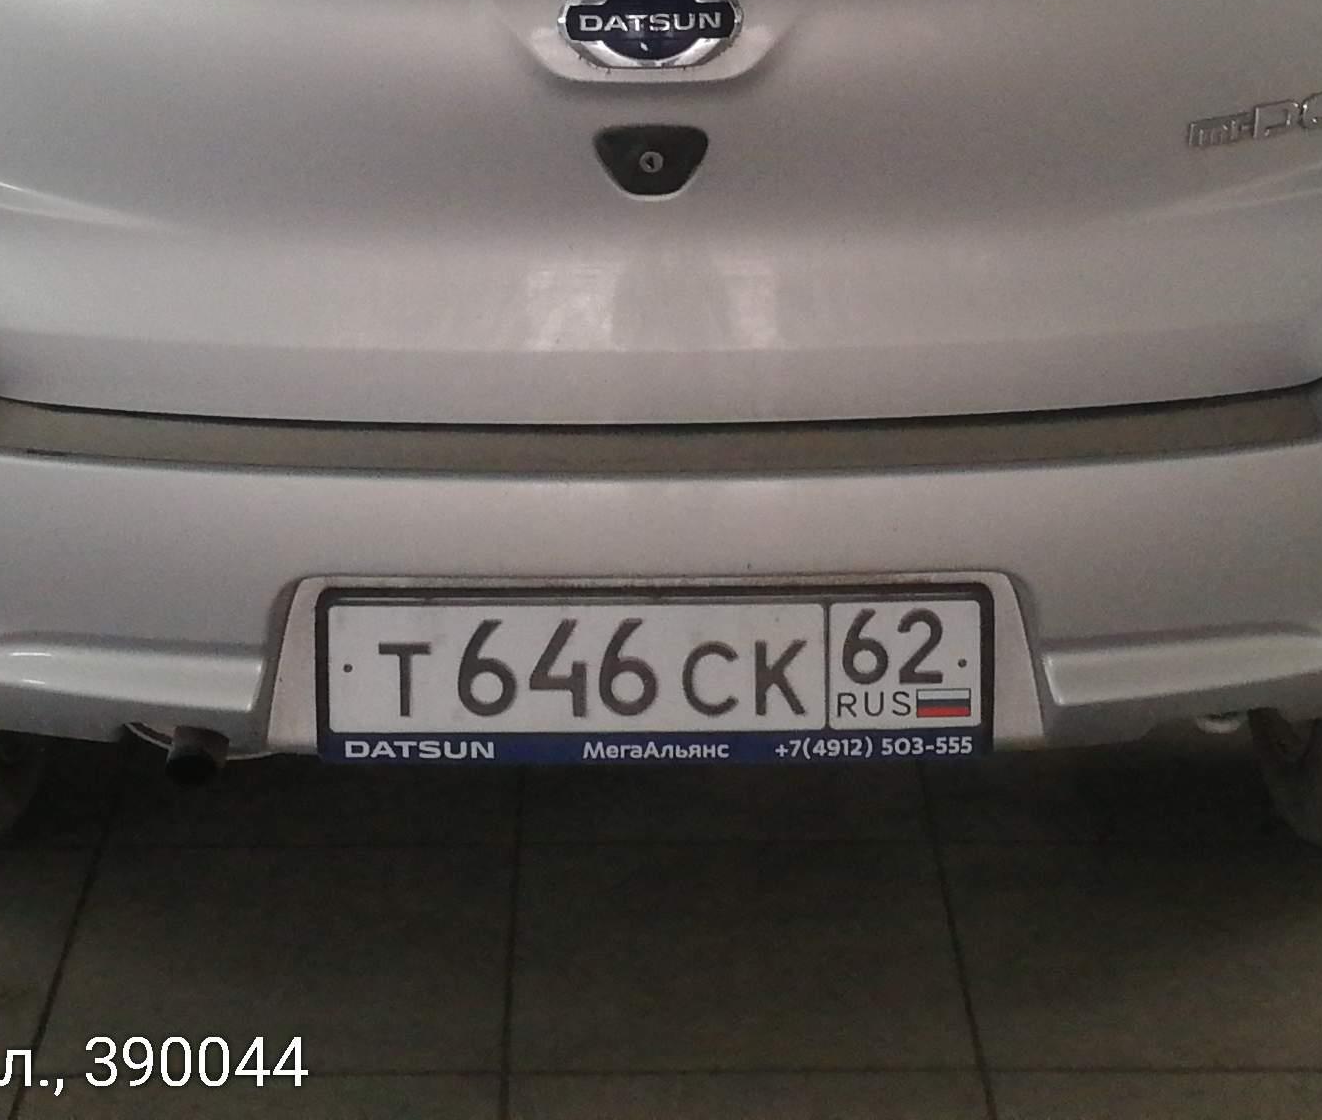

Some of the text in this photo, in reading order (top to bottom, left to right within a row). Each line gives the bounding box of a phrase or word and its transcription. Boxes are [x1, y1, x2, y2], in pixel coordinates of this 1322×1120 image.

[579, 11, 722, 32] DATSUN
[841, 608, 945, 685] 62
[836, 690, 912, 719] RUS
[344, 740, 495, 759] DATSUN
[582, 740, 730, 760] МегаАльянс
[881, 736, 974, 756] 503-555
